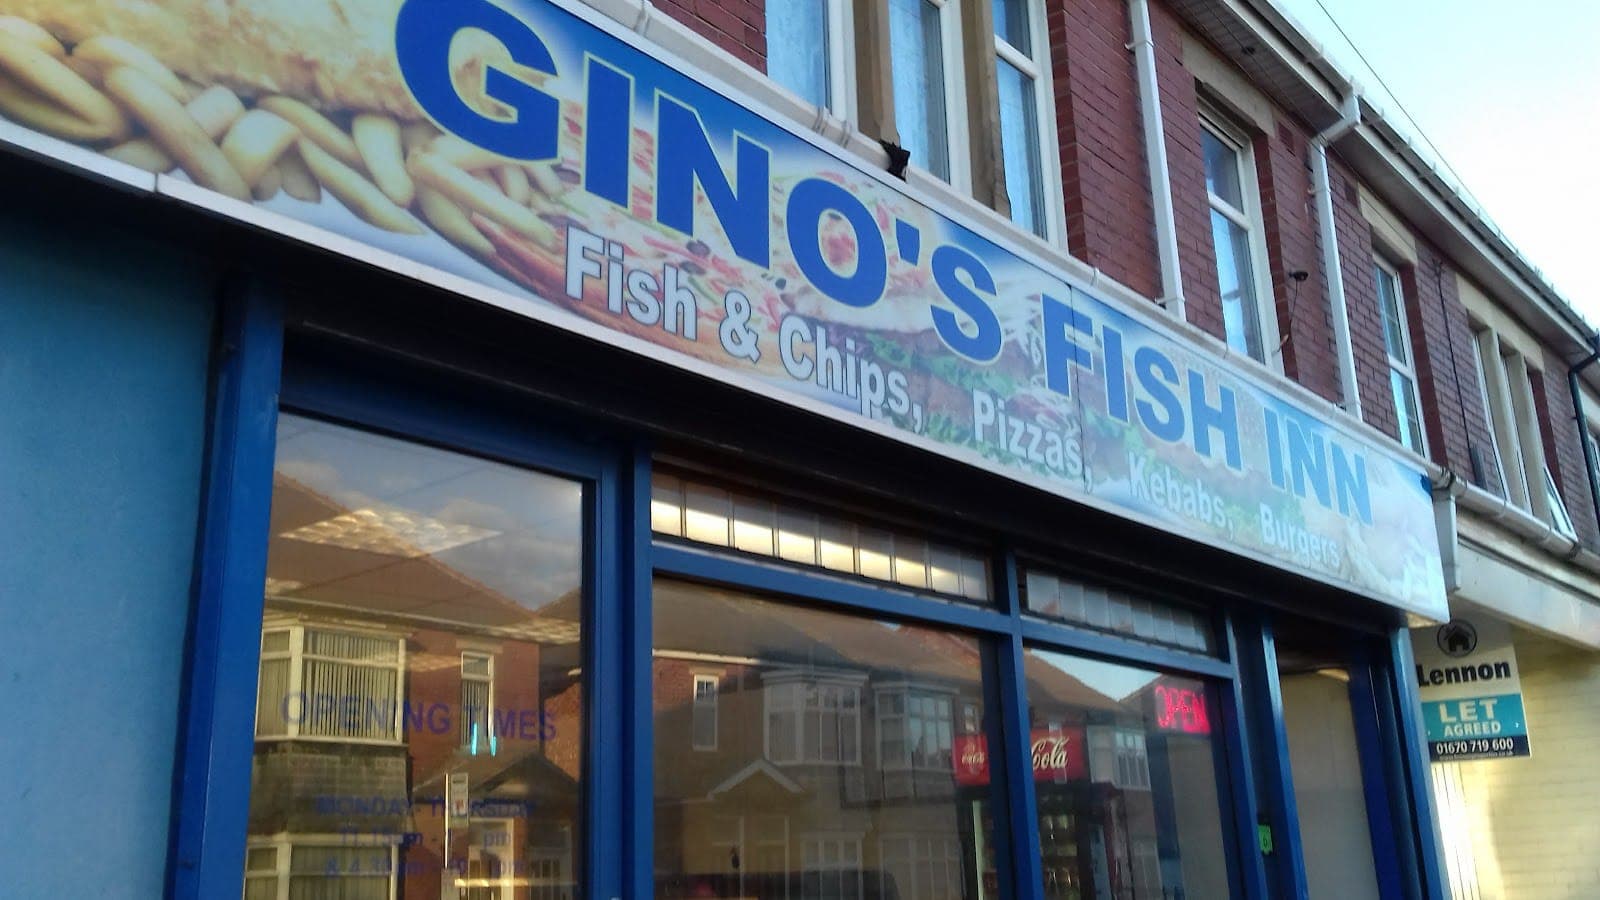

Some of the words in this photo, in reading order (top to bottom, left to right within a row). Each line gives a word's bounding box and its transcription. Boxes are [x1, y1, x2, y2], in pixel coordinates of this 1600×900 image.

[395, 0, 1004, 364] GINO'S
[1041, 292, 1243, 474] FISH
[1263, 405, 1375, 529] INN
[565, 224, 698, 342] Fish
[718, 289, 762, 364] &
[778, 314, 924, 434] Chips,
[973, 388, 1093, 495] Pizzas,
[1129, 453, 1235, 541] Kebabs,
[1259, 502, 1342, 570] Burgers
[1416, 661, 1511, 688] Lennon
[281, 692, 451, 735] OPENING
[1154, 684, 1211, 735] OPEN
[1438, 699, 1498, 723] LET
[1436, 741, 1468, 755] 01670
[1469, 739, 1489, 753] 719
[1492, 737, 1514, 751] 600
[1444, 721, 1501, 737] AGREED
